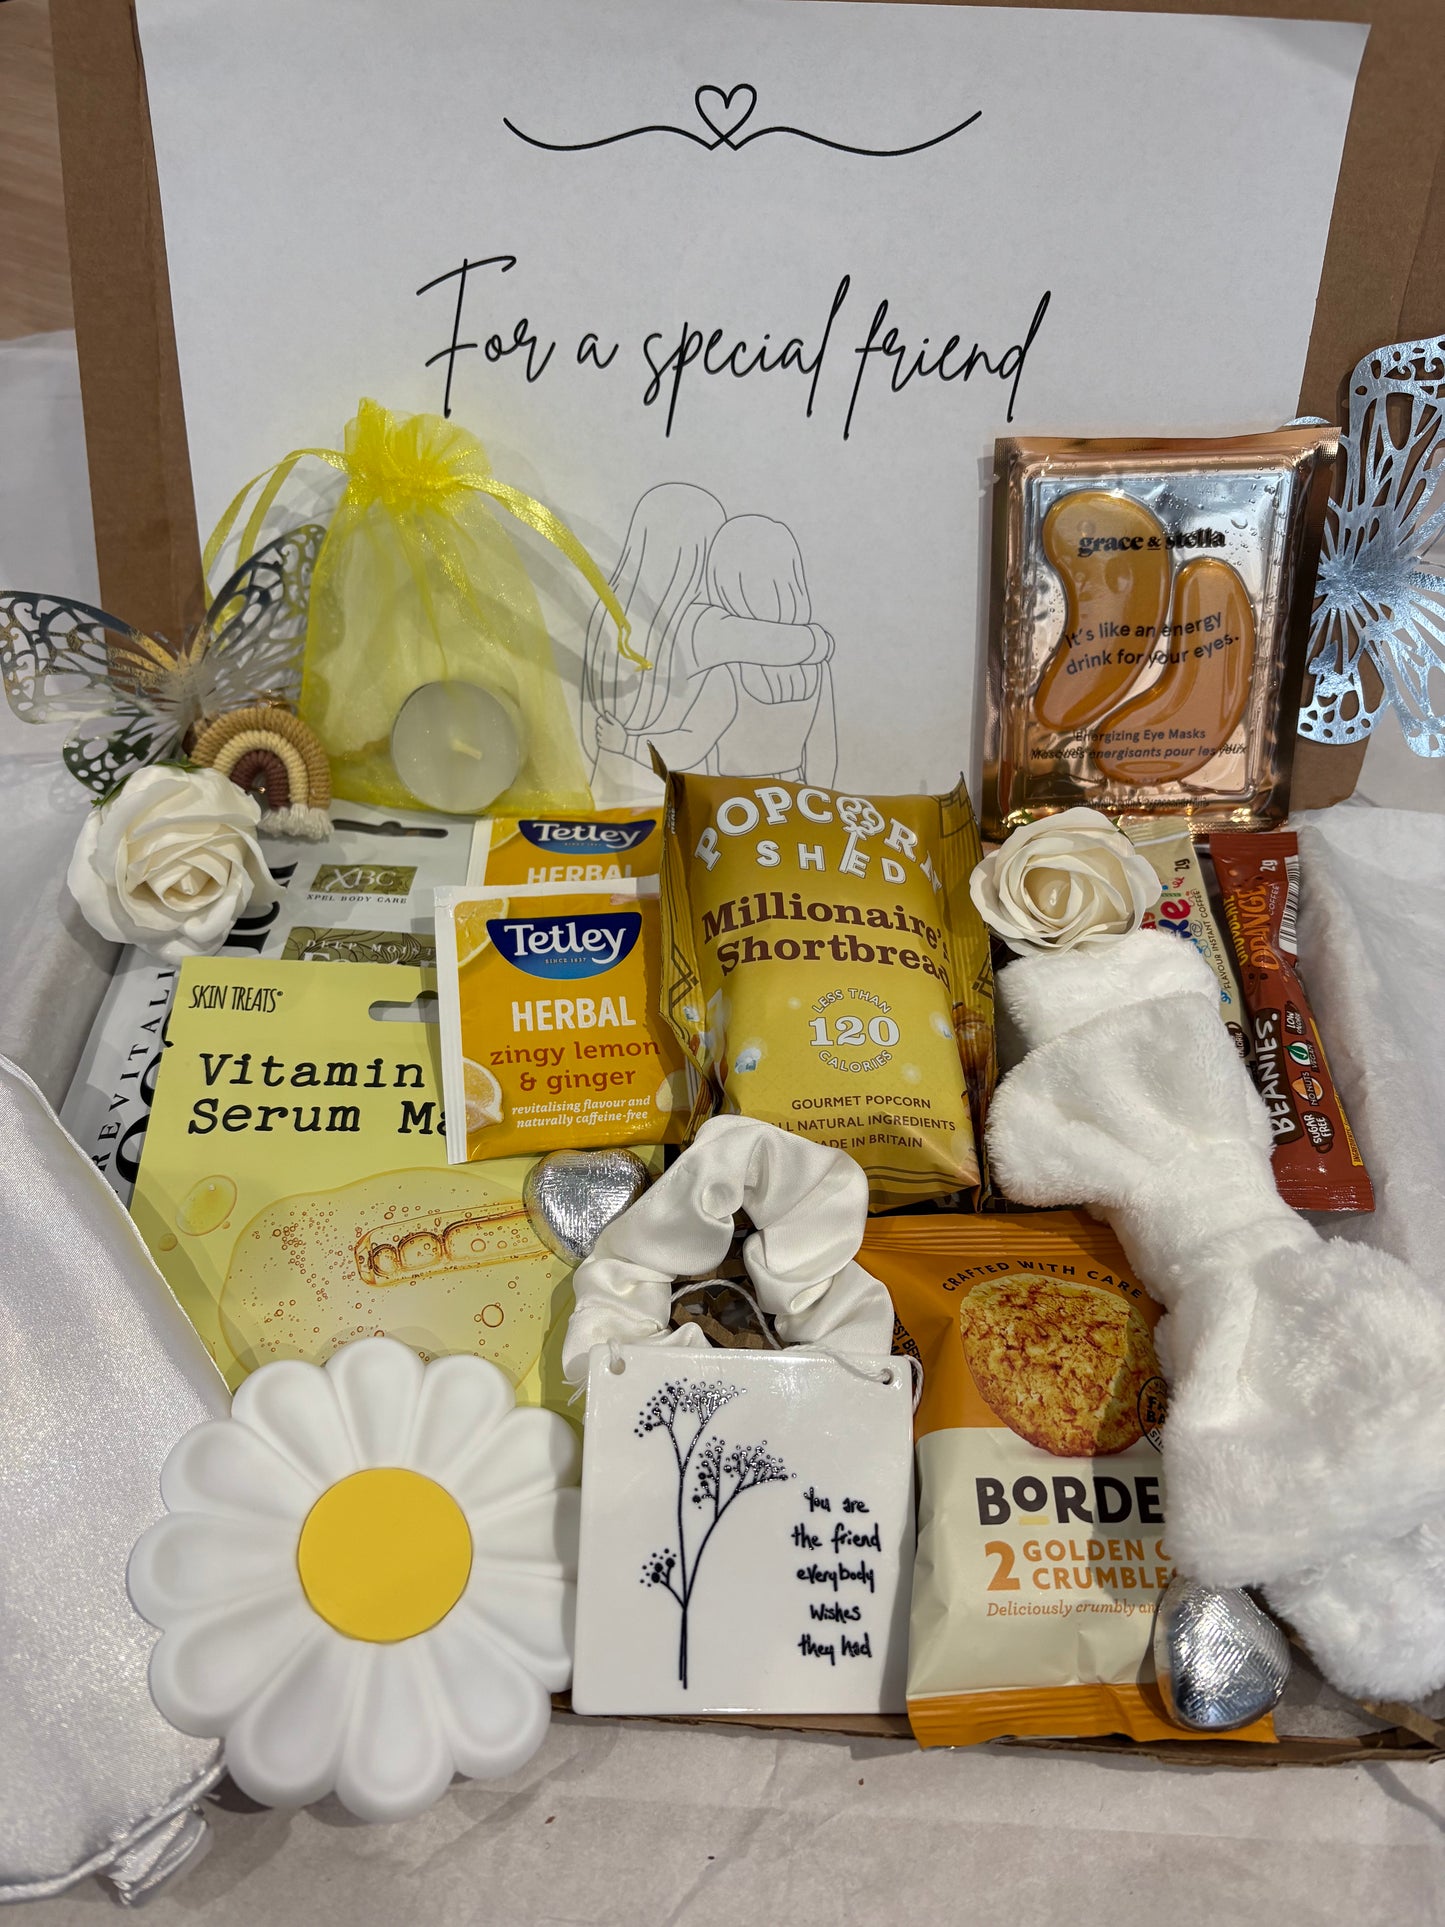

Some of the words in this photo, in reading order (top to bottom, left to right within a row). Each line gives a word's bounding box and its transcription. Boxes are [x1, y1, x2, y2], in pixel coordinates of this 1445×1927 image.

[417, 255, 555, 418] For
[576, 333, 619, 369] a
[643, 274, 851, 438] special
[843, 290, 1051, 441] friend
[1077, 534, 1144, 558] grace
[1147, 537, 1161, 550] &
[1165, 528, 1226, 550] stella
[1099, 622, 1131, 639] like
[1136, 625, 1156, 638] an
[1162, 611, 1223, 637] energy
[1066, 649, 1112, 676] drink
[1117, 648, 1144, 664] for
[1148, 649, 1190, 669] your
[1194, 635, 1240, 658] eyes.
[1075, 729, 1140, 744] Energizing
[1143, 729, 1165, 743] Eye
[1168, 728, 1206, 740] Masks
[1164, 746, 1195, 759] pour
[1197, 744, 1216, 757] les
[533, 822, 642, 849] Tetley
[756, 838, 906, 885] SHED
[1174, 858, 1191, 872] 2g
[1260, 859, 1278, 872] 2g
[325, 867, 397, 892] XBC
[306, 893, 335, 902] XPEL
[340, 894, 372, 903] BODY
[377, 896, 407, 904] CARE
[1194, 890, 1209, 918] COFFEE
[503, 921, 627, 964] Tetley
[1203, 920, 1220, 952] INSTANT
[1214, 954, 1232, 989] FLAVOUR
[188, 985, 228, 1010] SKIN
[812, 988, 844, 1013] LESS
[848, 988, 892, 1014] THAN
[511, 996, 636, 1032] HERBAL
[809, 1015, 900, 1047] 120
[490, 1044, 565, 1067] zingy
[574, 1040, 660, 1060] lemon
[818, 1050, 893, 1073] CALORIES
[199, 1053, 425, 1087] Vitamin
[520, 1071, 537, 1092] &
[547, 1069, 636, 1095] ginger
[511, 1098, 581, 1115] revitalising
[582, 1098, 626, 1114] flavour
[628, 1095, 651, 1107] and
[791, 1095, 861, 1110] GOURMET
[865, 1095, 931, 1109] POPCORN
[187, 1098, 361, 1135] Serum
[516, 1112, 573, 1129] naturally
[576, 1109, 648, 1126] caffeine-free
[797, 1116, 865, 1132] NATURAL
[868, 1113, 956, 1132] INGREDIENTS
[1305, 1114, 1322, 1144] SUGAR
[1317, 1117, 1332, 1137] FREE
[851, 1136, 866, 1148] IN
[869, 1133, 923, 1148] BRITAIN
[942, 1261, 1010, 1292] CRAFTED
[1017, 1260, 1075, 1276] WITH
[1087, 1270, 1143, 1299] CARE
[843, 1497, 869, 1513] are
[791, 1523, 823, 1549] the
[831, 1522, 882, 1553] friend
[985, 1541, 1021, 1591] 2
[1023, 1539, 1145, 1561] GOLDEN
[1032, 1567, 1176, 1591] CRUMBLE
[987, 1600, 1071, 1617] Deliciously
[1075, 1598, 1135, 1615] crumbly
[798, 1633, 835, 1666] they
[842, 1633, 872, 1658] had
